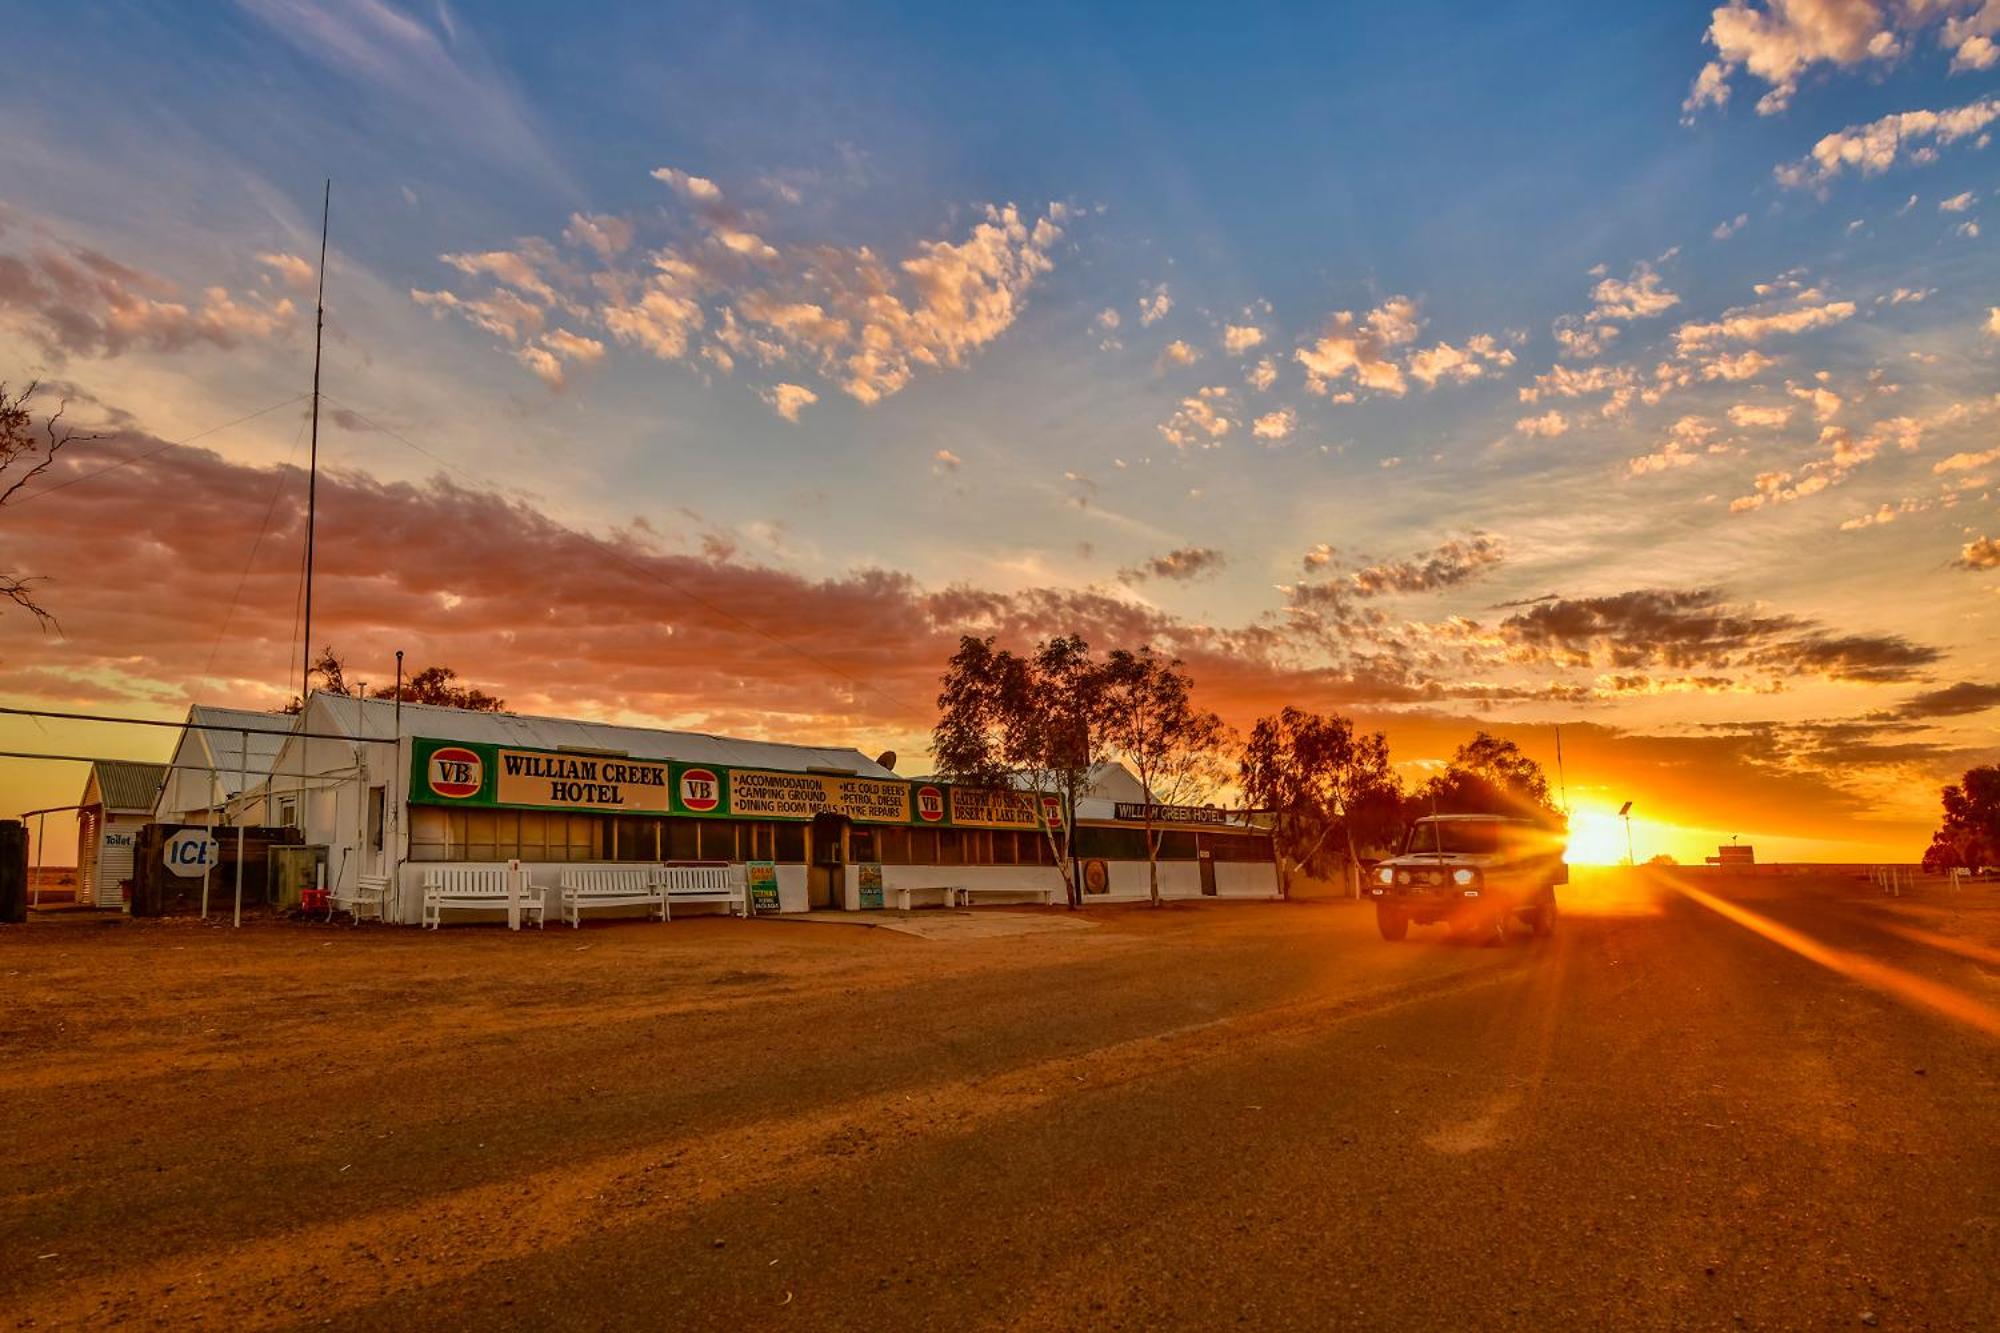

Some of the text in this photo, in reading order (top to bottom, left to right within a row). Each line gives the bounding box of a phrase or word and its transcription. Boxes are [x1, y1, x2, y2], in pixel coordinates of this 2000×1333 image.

[438, 760, 471, 783] VB
[504, 755, 665, 786] WILLIAM CREEK
[687, 781, 713, 799] VB
[739, 775, 822, 790] ACCOMMODATION
[843, 782, 857, 793] ICE
[858, 783, 879, 794] COLD
[551, 781, 624, 804] HOTEL
[739, 787, 826, 802] CAMPING GROUND
[740, 800, 837, 814] DINING ROOM MEALS
[845, 804, 899, 817] TYRE REPAIRS
[922, 796, 939, 811] VB
[1119, 804, 1158, 819] WILLIM
[106, 833, 131, 846] Toilet
